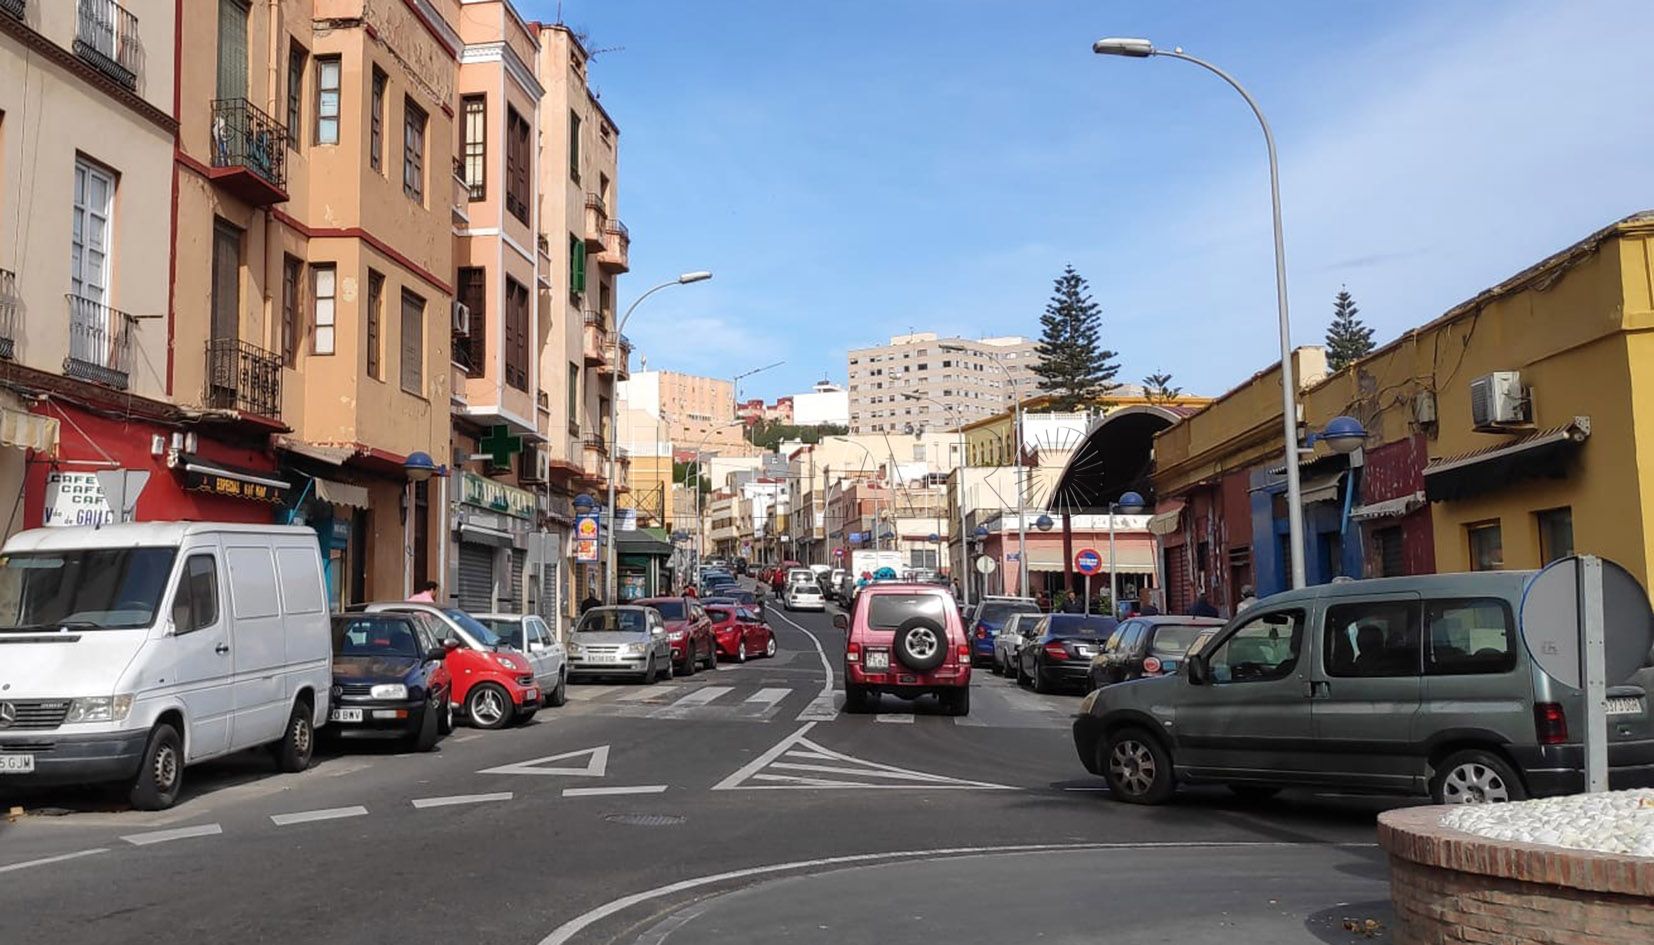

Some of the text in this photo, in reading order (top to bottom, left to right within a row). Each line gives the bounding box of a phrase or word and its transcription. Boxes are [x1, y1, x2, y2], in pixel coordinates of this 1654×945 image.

[50, 474, 96, 484] CAFE
[72, 495, 105, 505] CAF
[8, 756, 31, 769] GJM
